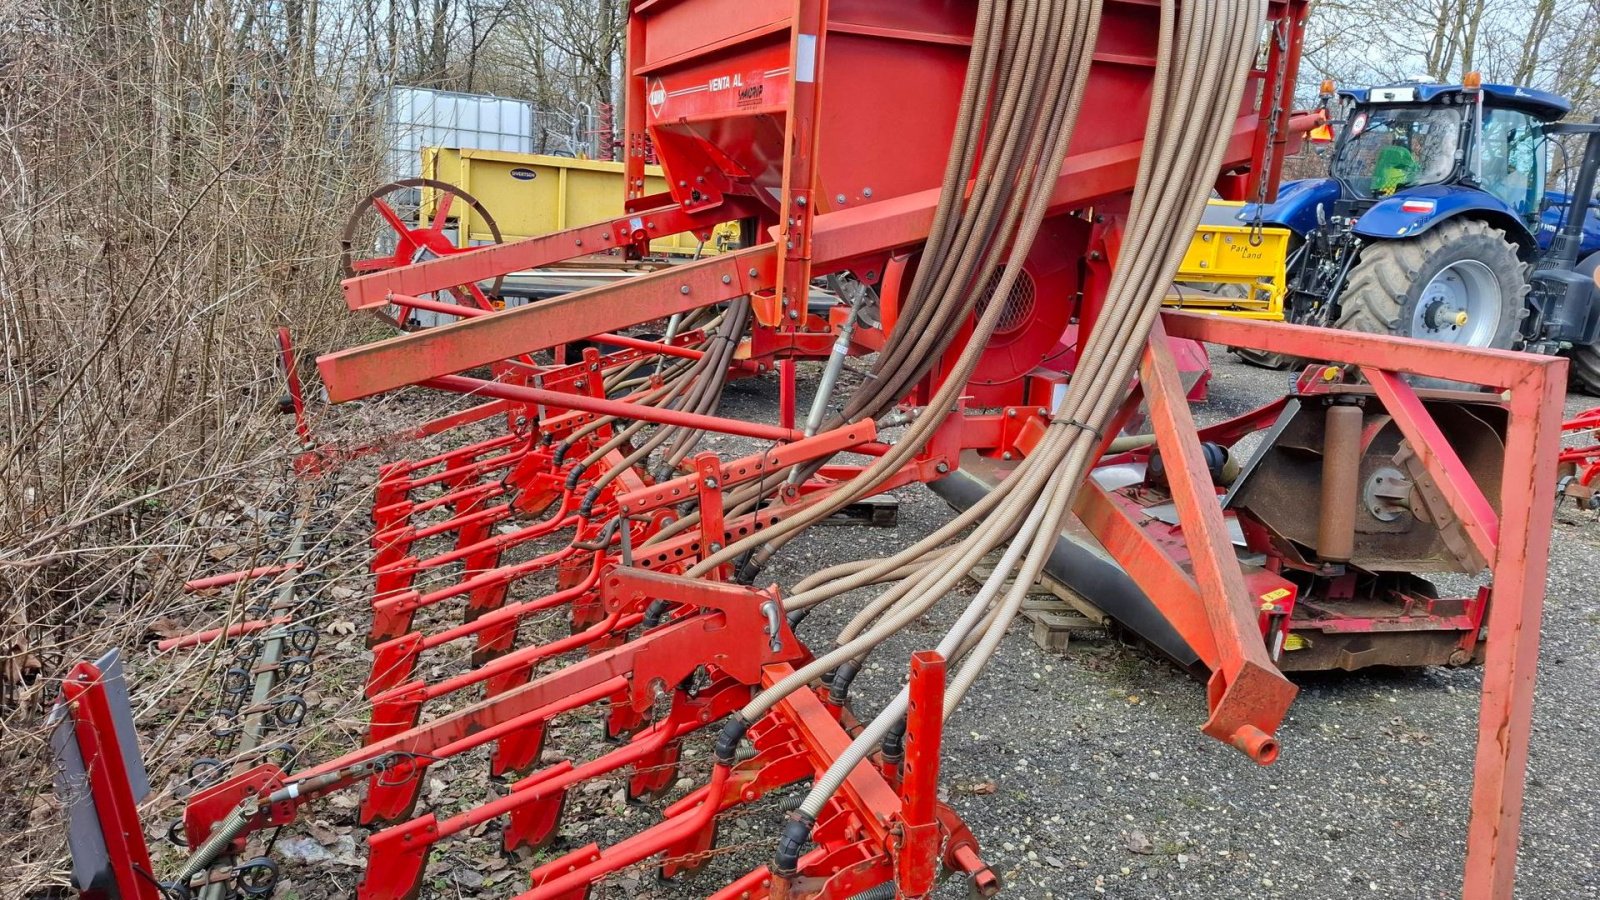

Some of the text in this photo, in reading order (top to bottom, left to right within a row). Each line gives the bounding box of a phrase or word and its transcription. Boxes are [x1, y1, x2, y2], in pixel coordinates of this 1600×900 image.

[709, 76, 730, 91] VENTA
[732, 73, 743, 87] AL
[1230, 244, 1249, 253] Park
